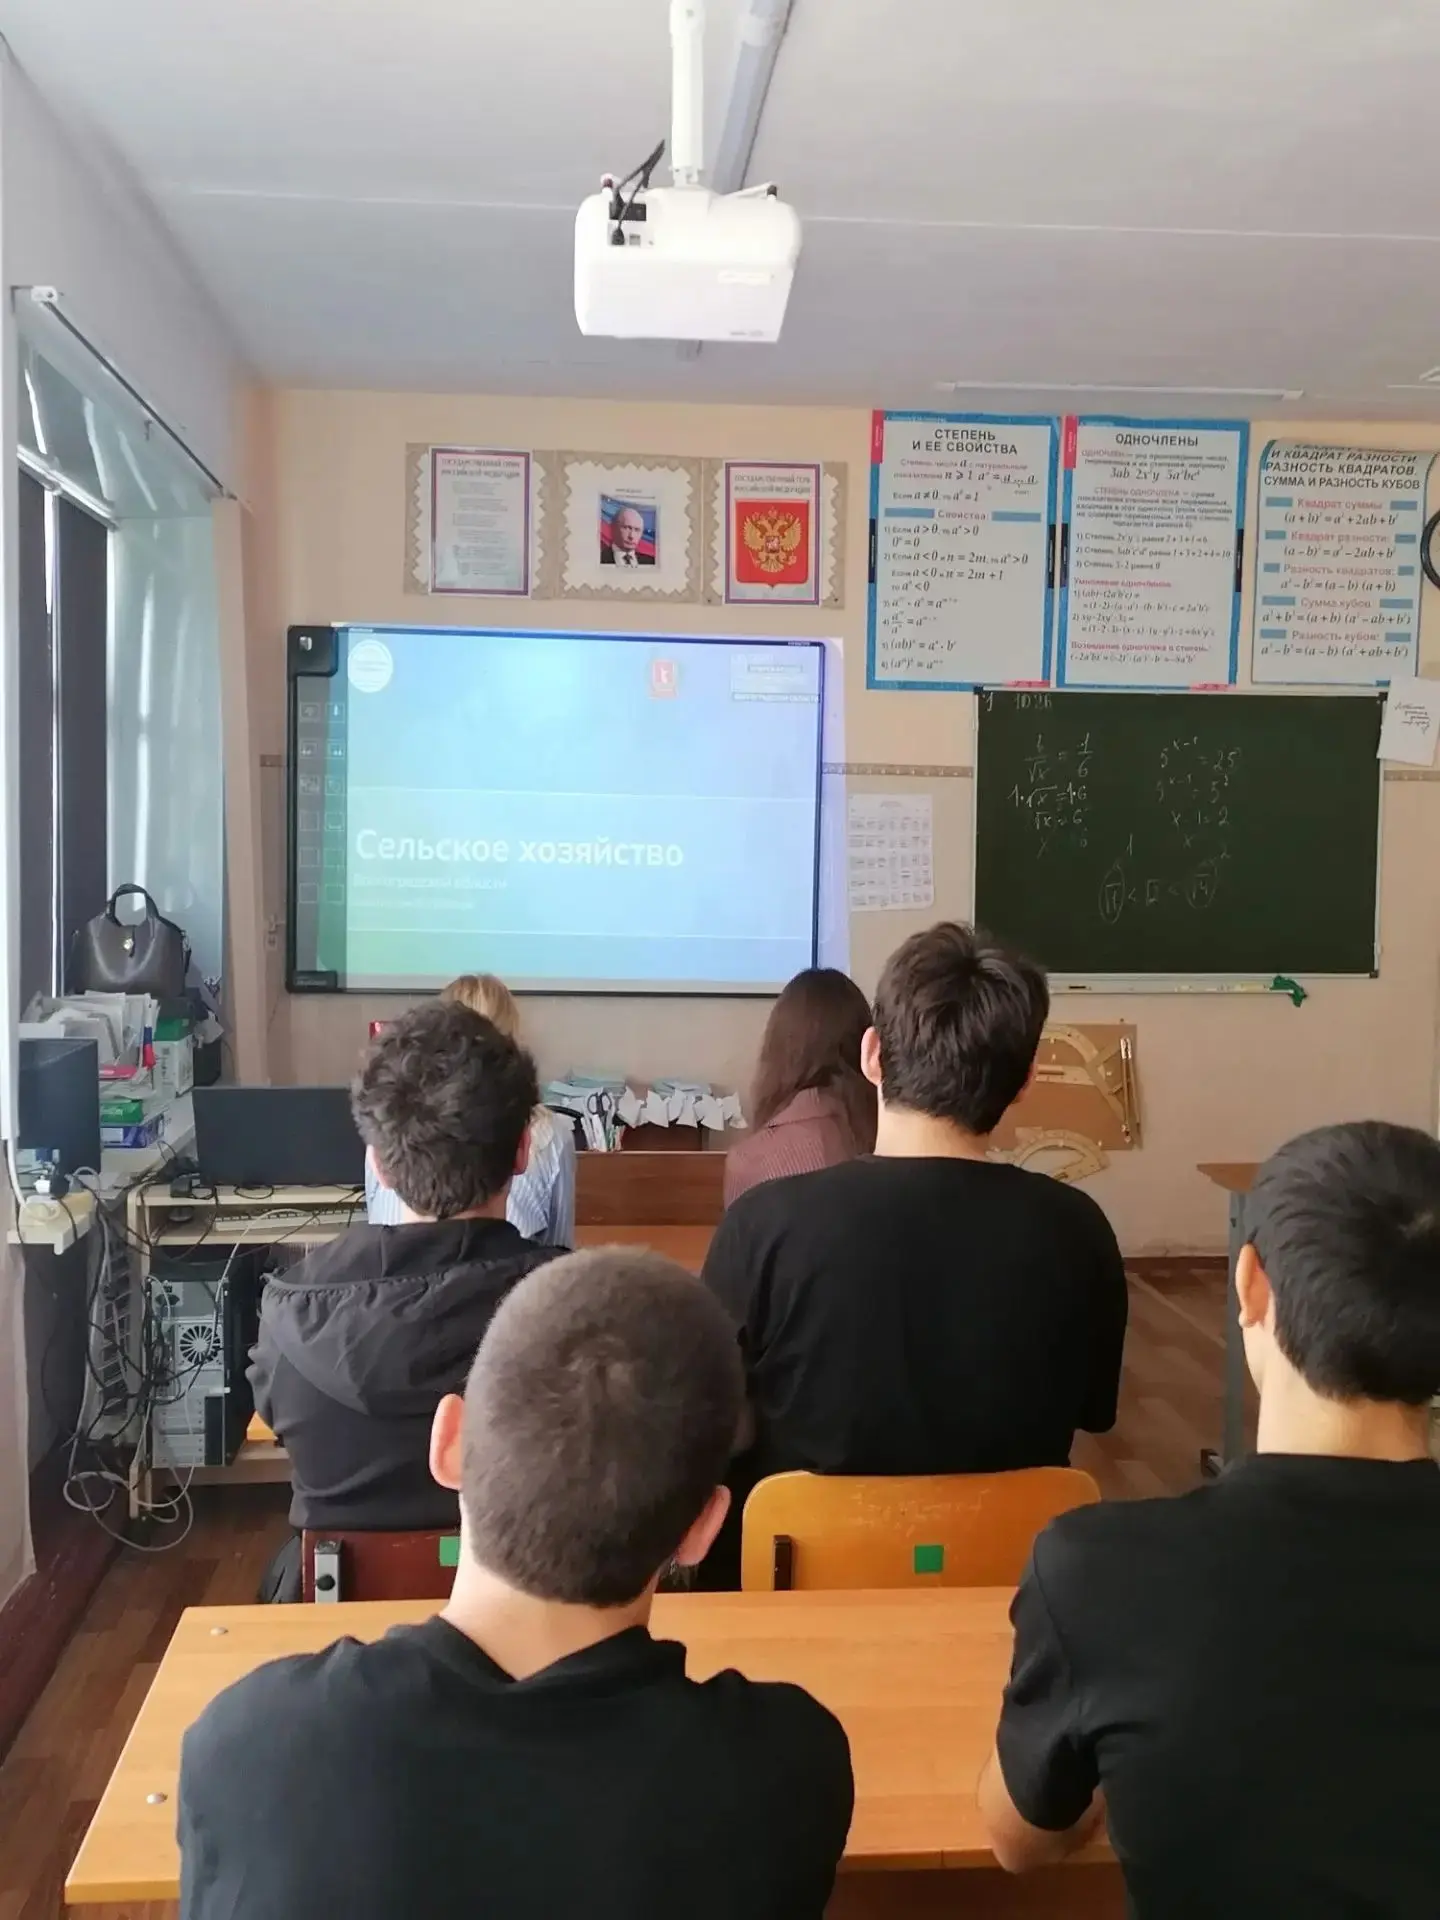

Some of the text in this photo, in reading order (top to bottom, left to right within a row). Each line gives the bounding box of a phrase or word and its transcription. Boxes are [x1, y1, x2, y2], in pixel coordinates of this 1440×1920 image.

[935, 429, 996, 440] СТЕПЕНЬ
[1116, 433, 1198, 447] ОДНОЧЛЕНЫ
[913, 441, 1018, 455] И ЕЕ СВОЙСТВА
[1271, 450, 1416, 462] И КВАДРАТ РАЗНОСТИ
[1265, 462, 1333, 473] РАЗНОСТЬ
[1264, 476, 1420, 489] СУММА И РАЗНОСТЬ КУБОВ
[355, 828, 684, 867] Сельское хозяйство
